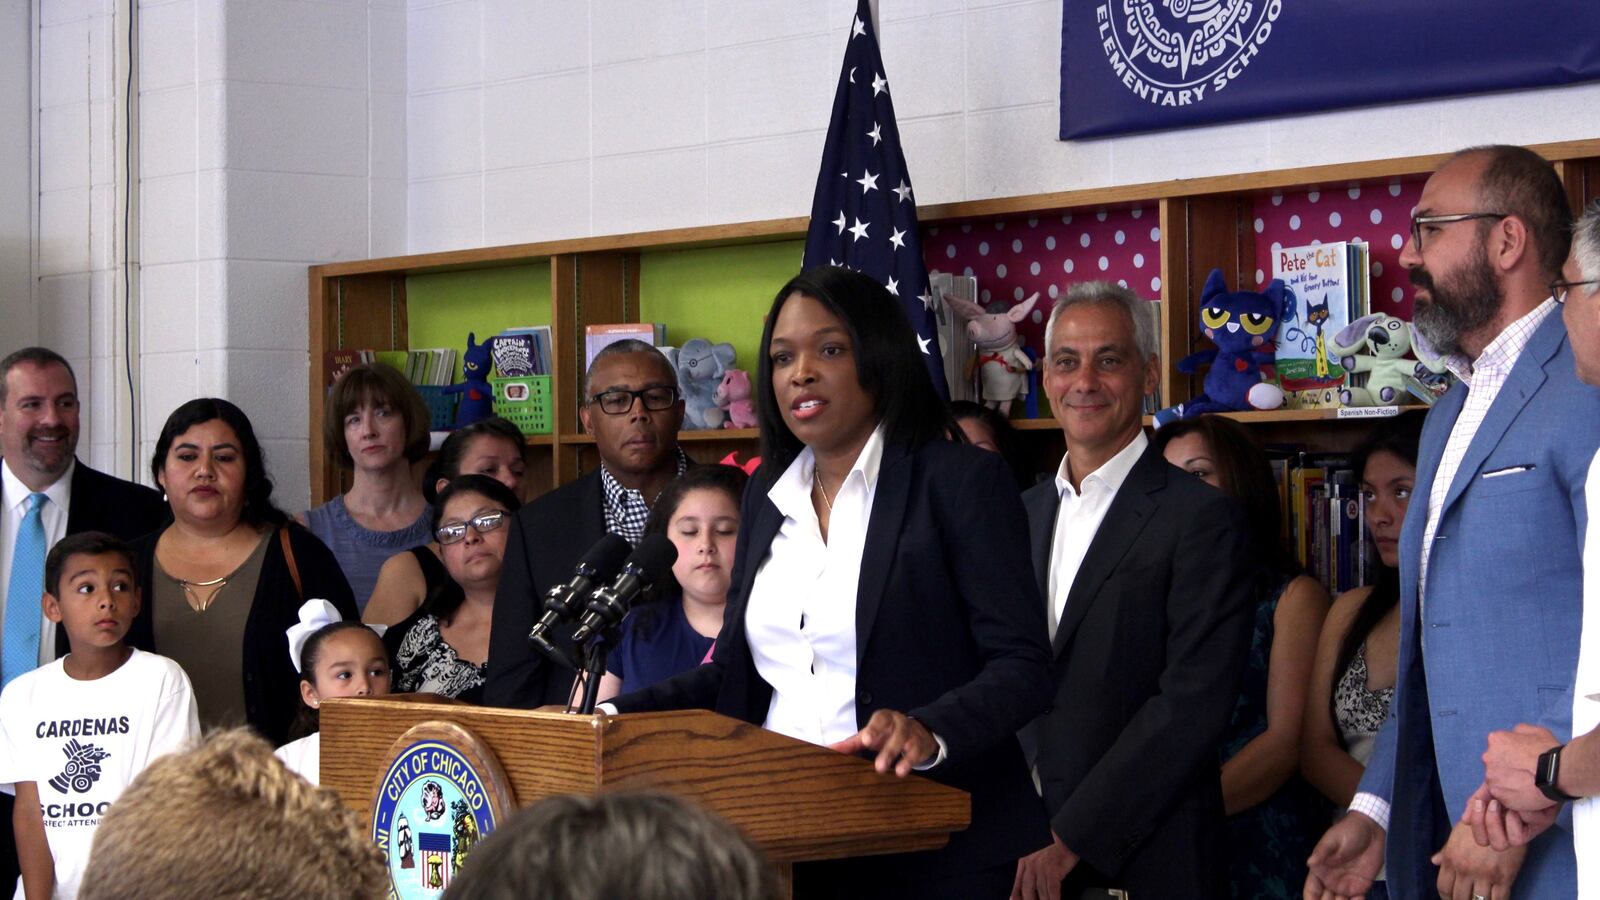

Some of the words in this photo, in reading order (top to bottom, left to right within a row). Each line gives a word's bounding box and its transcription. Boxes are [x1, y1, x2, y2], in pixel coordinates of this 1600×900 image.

[1096, 4, 1207, 107] ELEMENTARY
[1213, 0, 1282, 92] SCHOO
[1281, 252, 1306, 272] Pete
[1306, 251, 1315, 261] the
[1315, 249, 1336, 268] Cat
[493, 338, 526, 349] CAPTAIN
[334, 355, 353, 365] DIARY
[1340, 409, 1364, 417] Spanish
[1364, 408, 1397, 416] Non-Fiction
[36, 716, 130, 739] CARDENAS
[387, 762, 411, 801] CITY
[412, 752, 428, 774] OF
[431, 751, 483, 811] CHICAGO
[40, 801, 112, 819] CHOO
